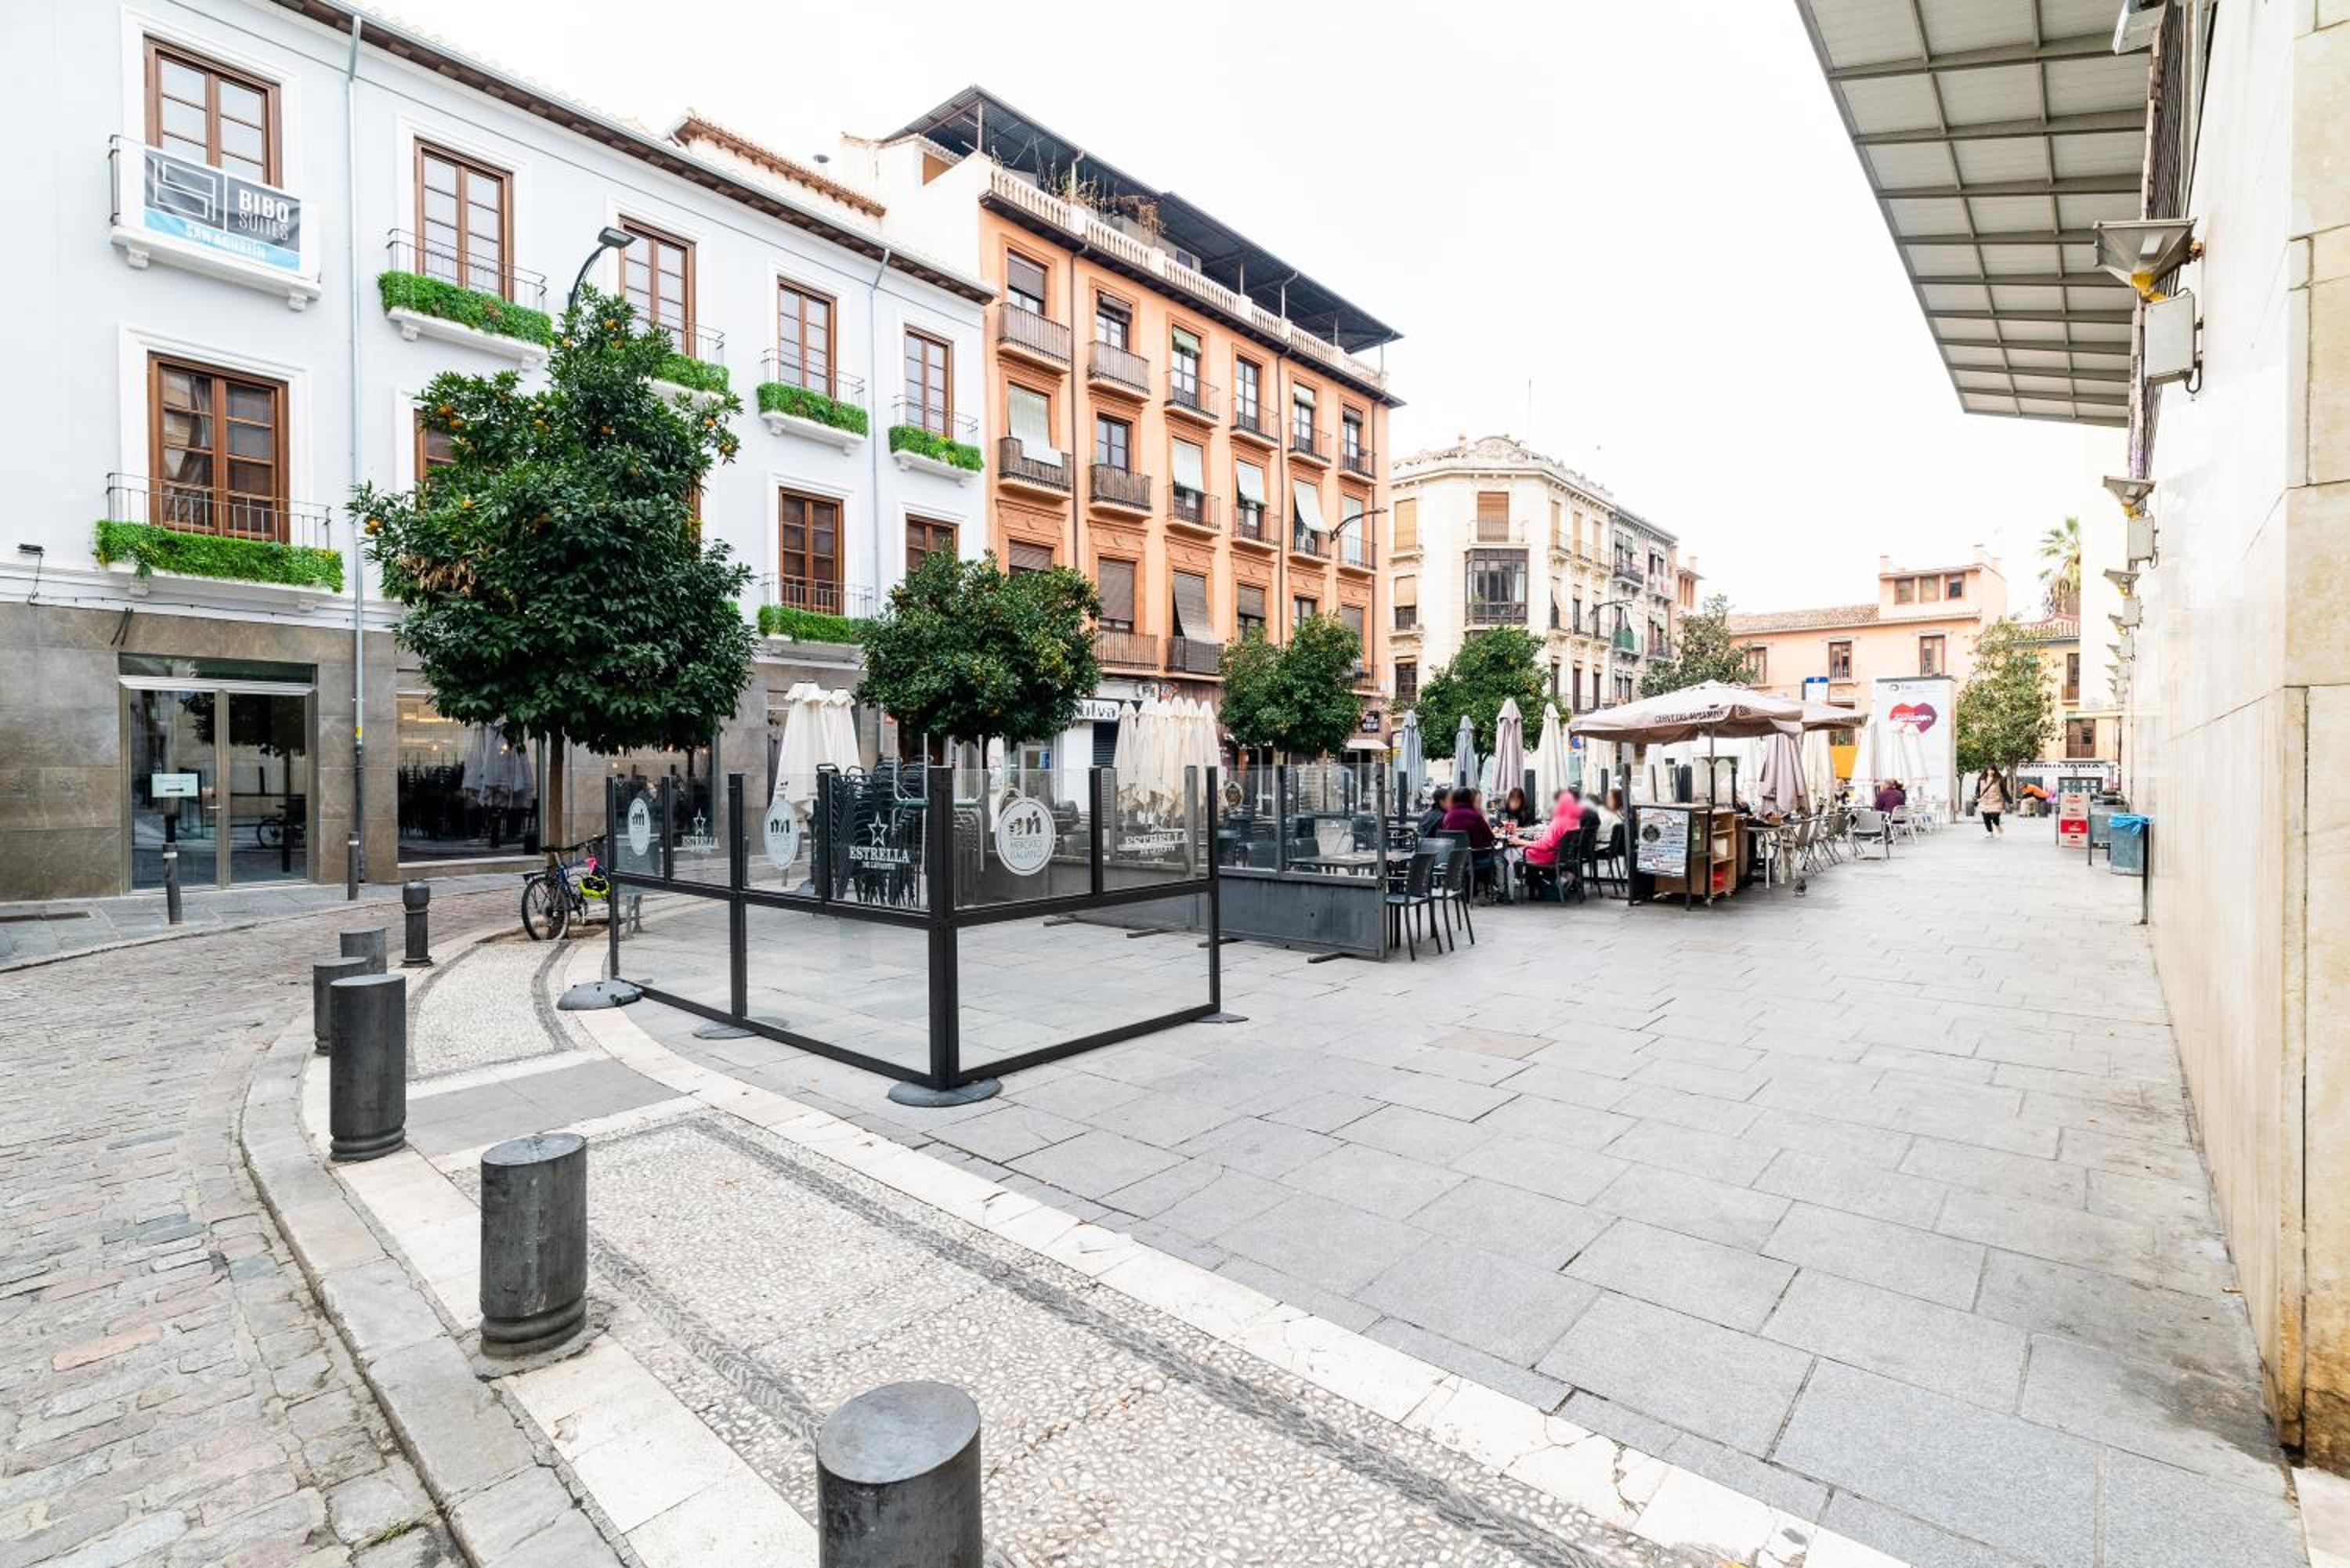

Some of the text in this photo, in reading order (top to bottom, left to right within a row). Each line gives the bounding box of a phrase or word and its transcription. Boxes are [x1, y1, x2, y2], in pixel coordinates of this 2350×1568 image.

[239, 189, 289, 223] BIBO
[239, 211, 288, 241] SUITES
[682, 835, 720, 850] ESTRELLA
[1125, 832, 1190, 847] ESTRELLA
[848, 845, 911, 864] ESTRELLA
